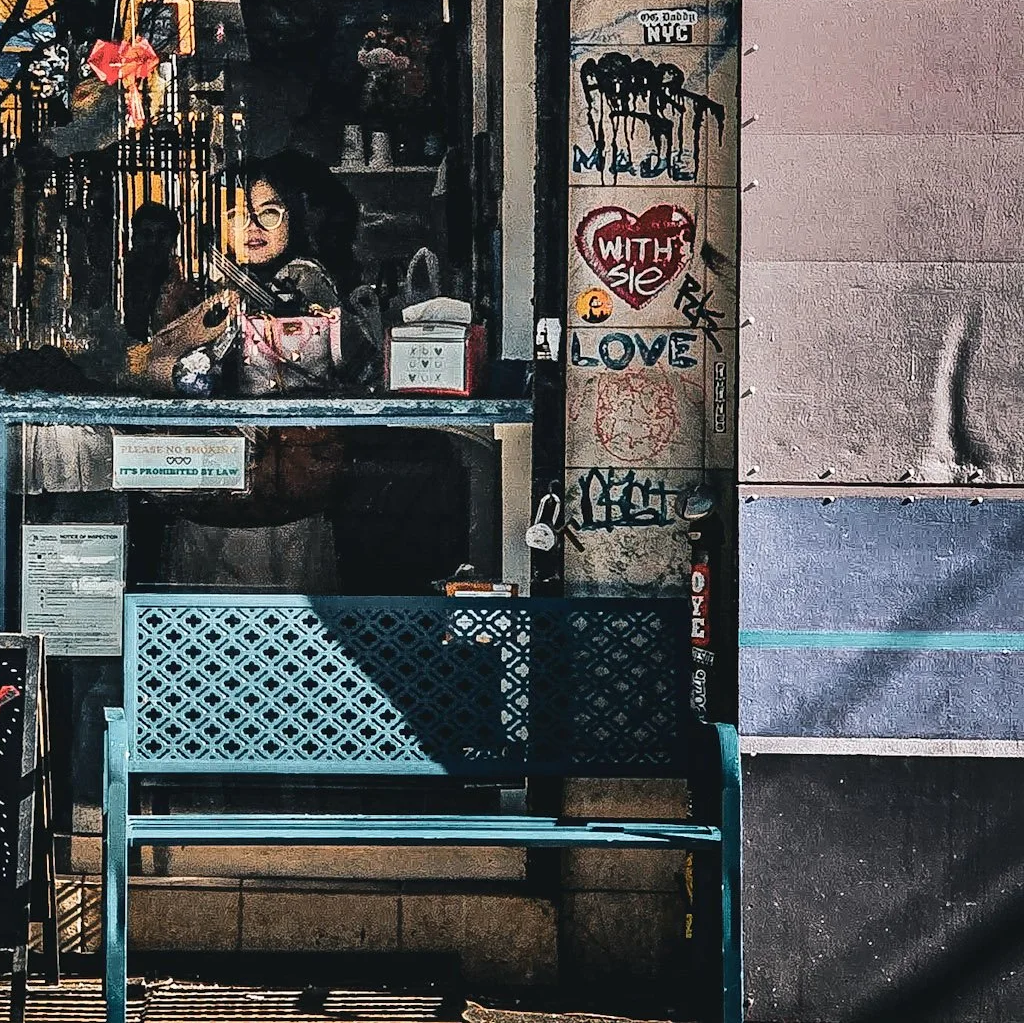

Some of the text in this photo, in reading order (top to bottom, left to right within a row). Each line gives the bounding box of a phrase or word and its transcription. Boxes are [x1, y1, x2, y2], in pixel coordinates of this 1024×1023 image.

[647, 25, 688, 43] NYC
[597, 236, 674, 264] WITH
[571, 331, 699, 371] LOVE
[216, 468, 239, 476] LAW
